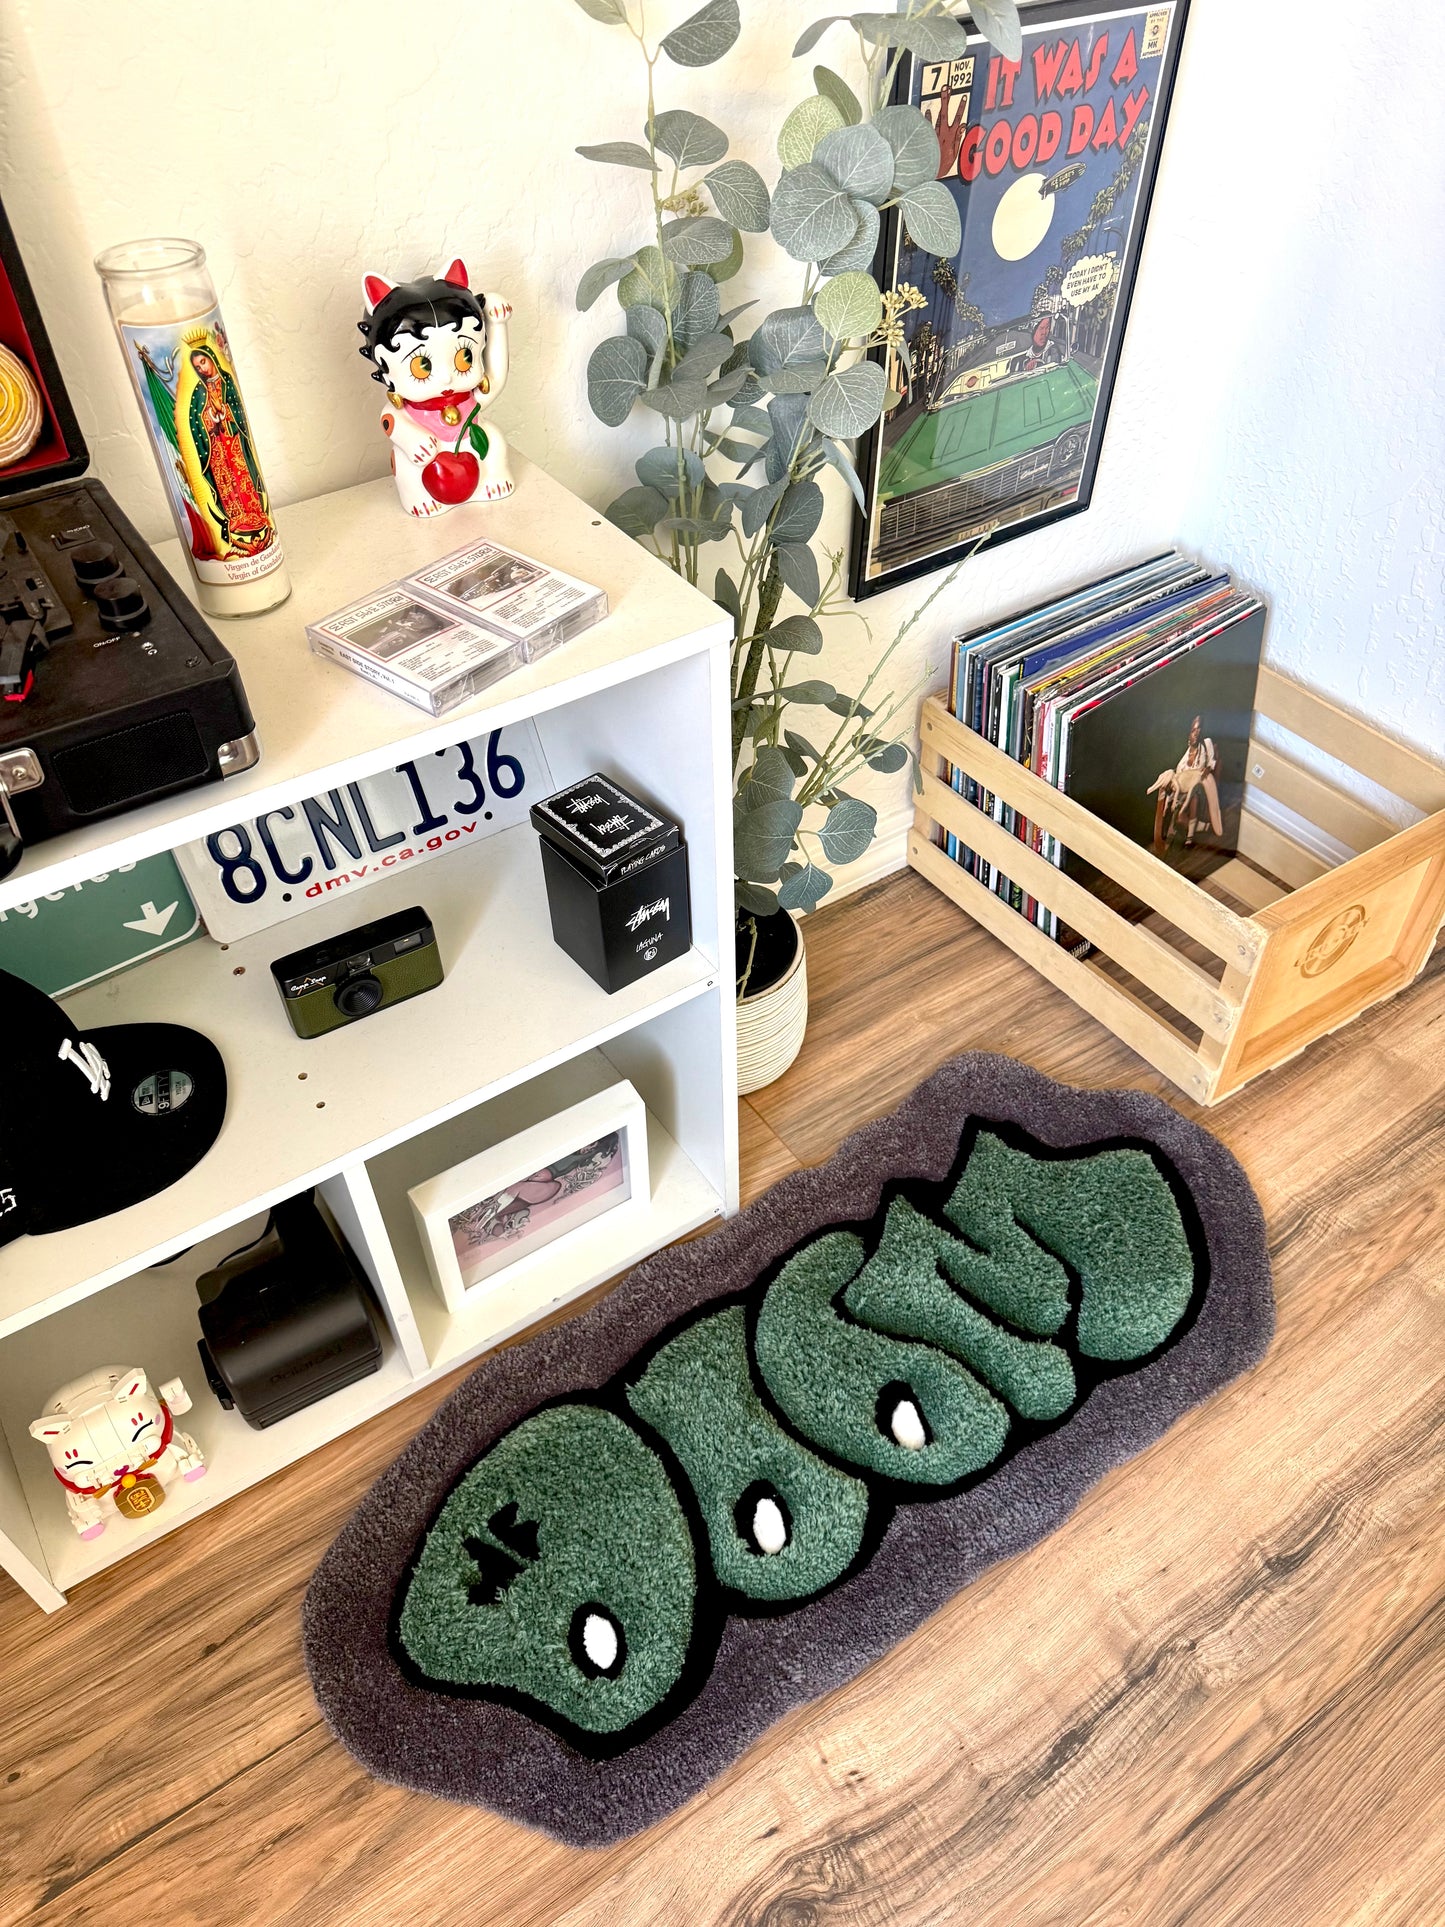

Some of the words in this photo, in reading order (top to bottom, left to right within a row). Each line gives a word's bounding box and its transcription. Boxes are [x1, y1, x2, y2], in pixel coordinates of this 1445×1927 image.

[931, 66, 942, 91] 7
[984, 56, 1022, 111] IT
[1032, 31, 1109, 100] WAS
[1111, 27, 1138, 87] A
[950, 72, 972, 88] 1992
[958, 111, 1063, 182] GOOD
[1066, 86, 1150, 156] DAY
[1066, 280, 1081, 290] EVEN
[1082, 274, 1098, 285] HAVE
[1099, 272, 1107, 280] TO
[1069, 269, 1087, 280] TODAY
[1091, 263, 1108, 273] DIDN'T
[1071, 288, 1082, 297] USE
[1082, 286, 1091, 294] MY
[1091, 283, 1100, 291] AK
[224, 562, 250, 572] Virgen
[250, 558, 260, 566] de
[227, 571, 251, 581] Virgin
[251, 566, 260, 576] of
[206, 727, 526, 904] 8CNL136
[304, 821, 478, 898] dmv.ca.gov
[620, 856, 645, 876] PLAYING
[645, 844, 667, 861] CARDS
[635, 932, 664, 953] LAGUNA
